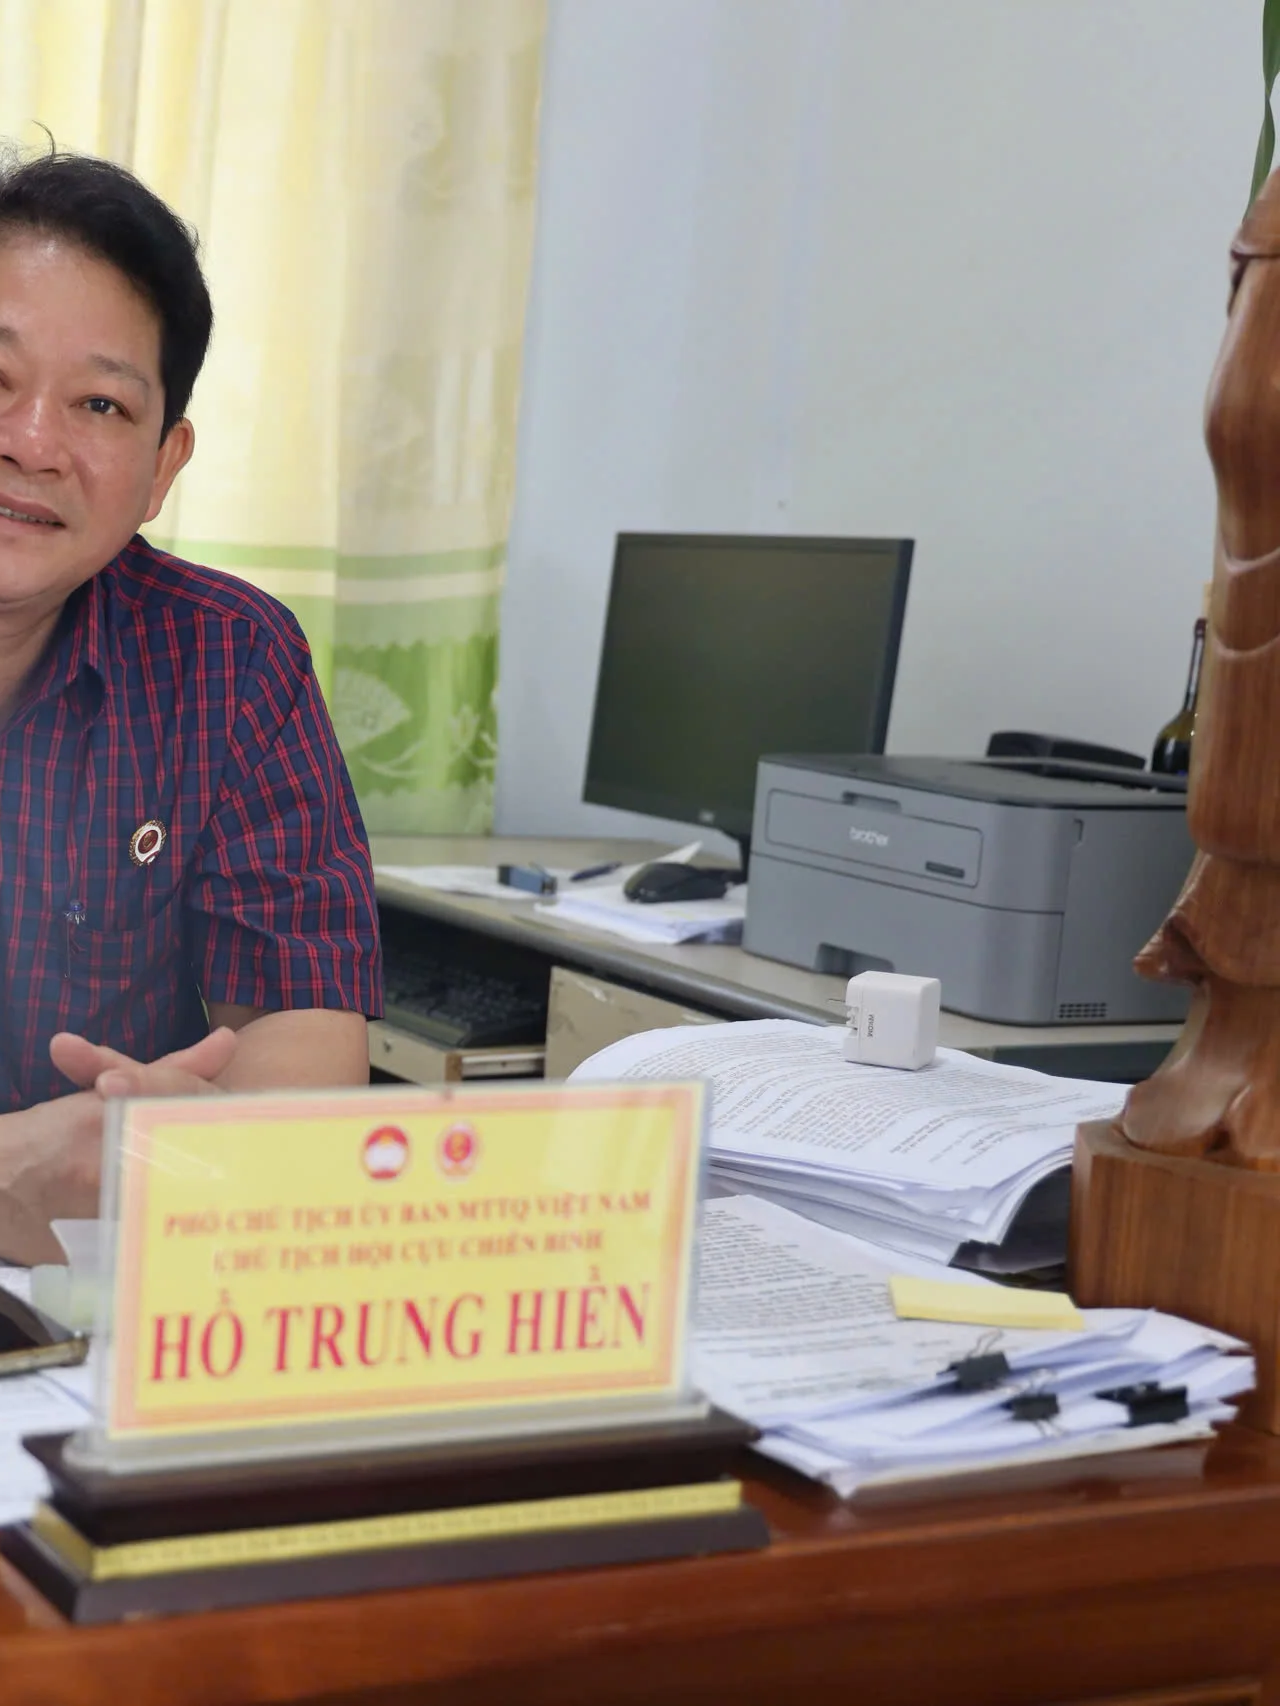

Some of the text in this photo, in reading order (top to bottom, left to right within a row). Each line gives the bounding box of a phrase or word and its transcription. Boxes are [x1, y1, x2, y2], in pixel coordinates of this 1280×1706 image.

[850, 825, 888, 847] brother
[400, 1202, 450, 1226] BAN
[457, 1196, 531, 1223] MTTQ
[597, 1189, 651, 1213] NAM
[544, 1229, 602, 1253] BINH
[265, 1292, 484, 1373] TRUNG
